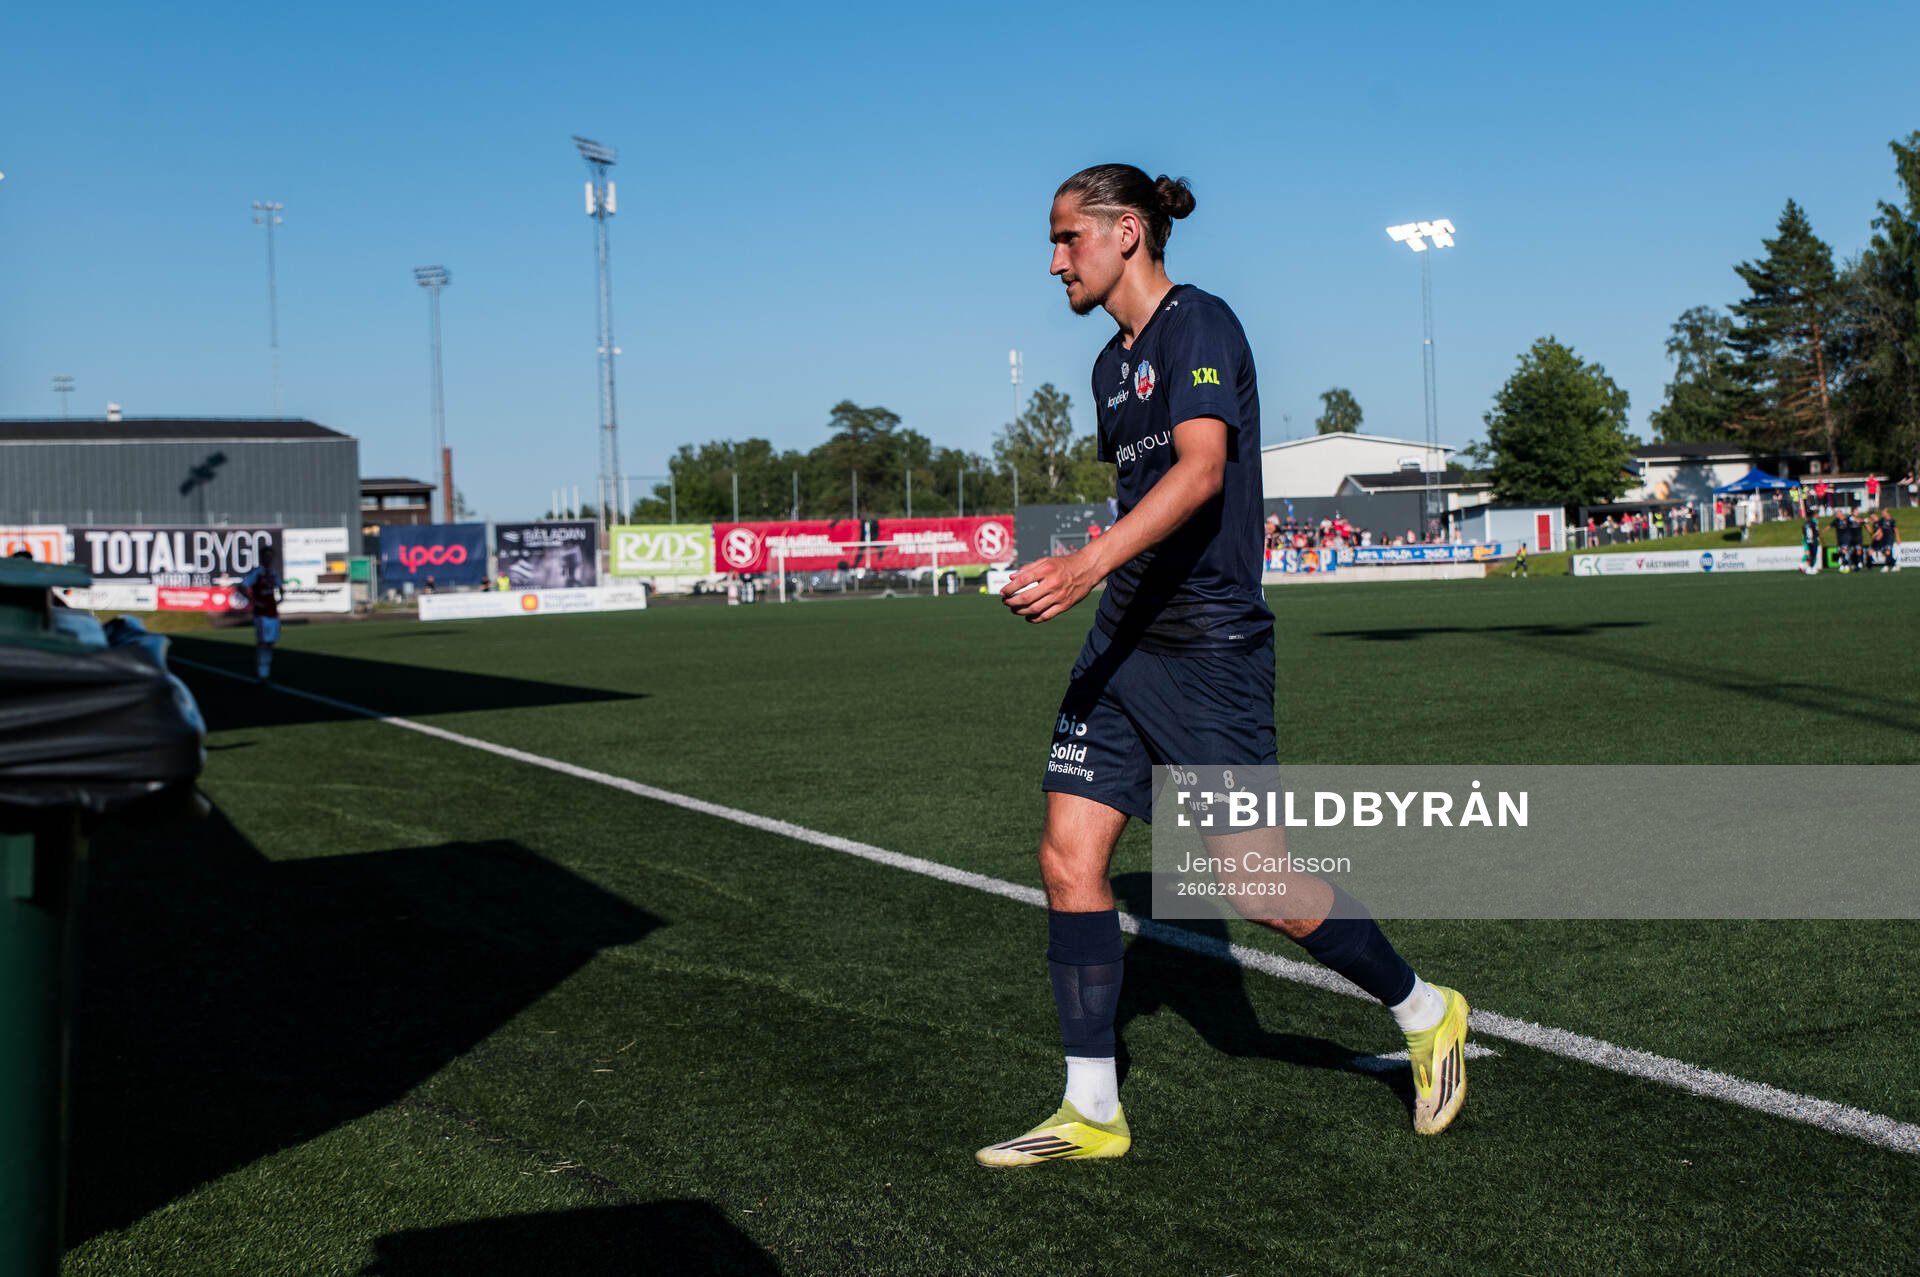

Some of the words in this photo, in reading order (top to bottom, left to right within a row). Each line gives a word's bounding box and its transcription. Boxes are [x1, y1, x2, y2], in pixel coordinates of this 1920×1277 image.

[1191, 367, 1220, 387] XXL
[617, 531, 705, 561] RYDS
[1050, 742, 1088, 763] Solid
[1047, 760, 1094, 782] Försäkring
[1222, 769, 1235, 790] 8
